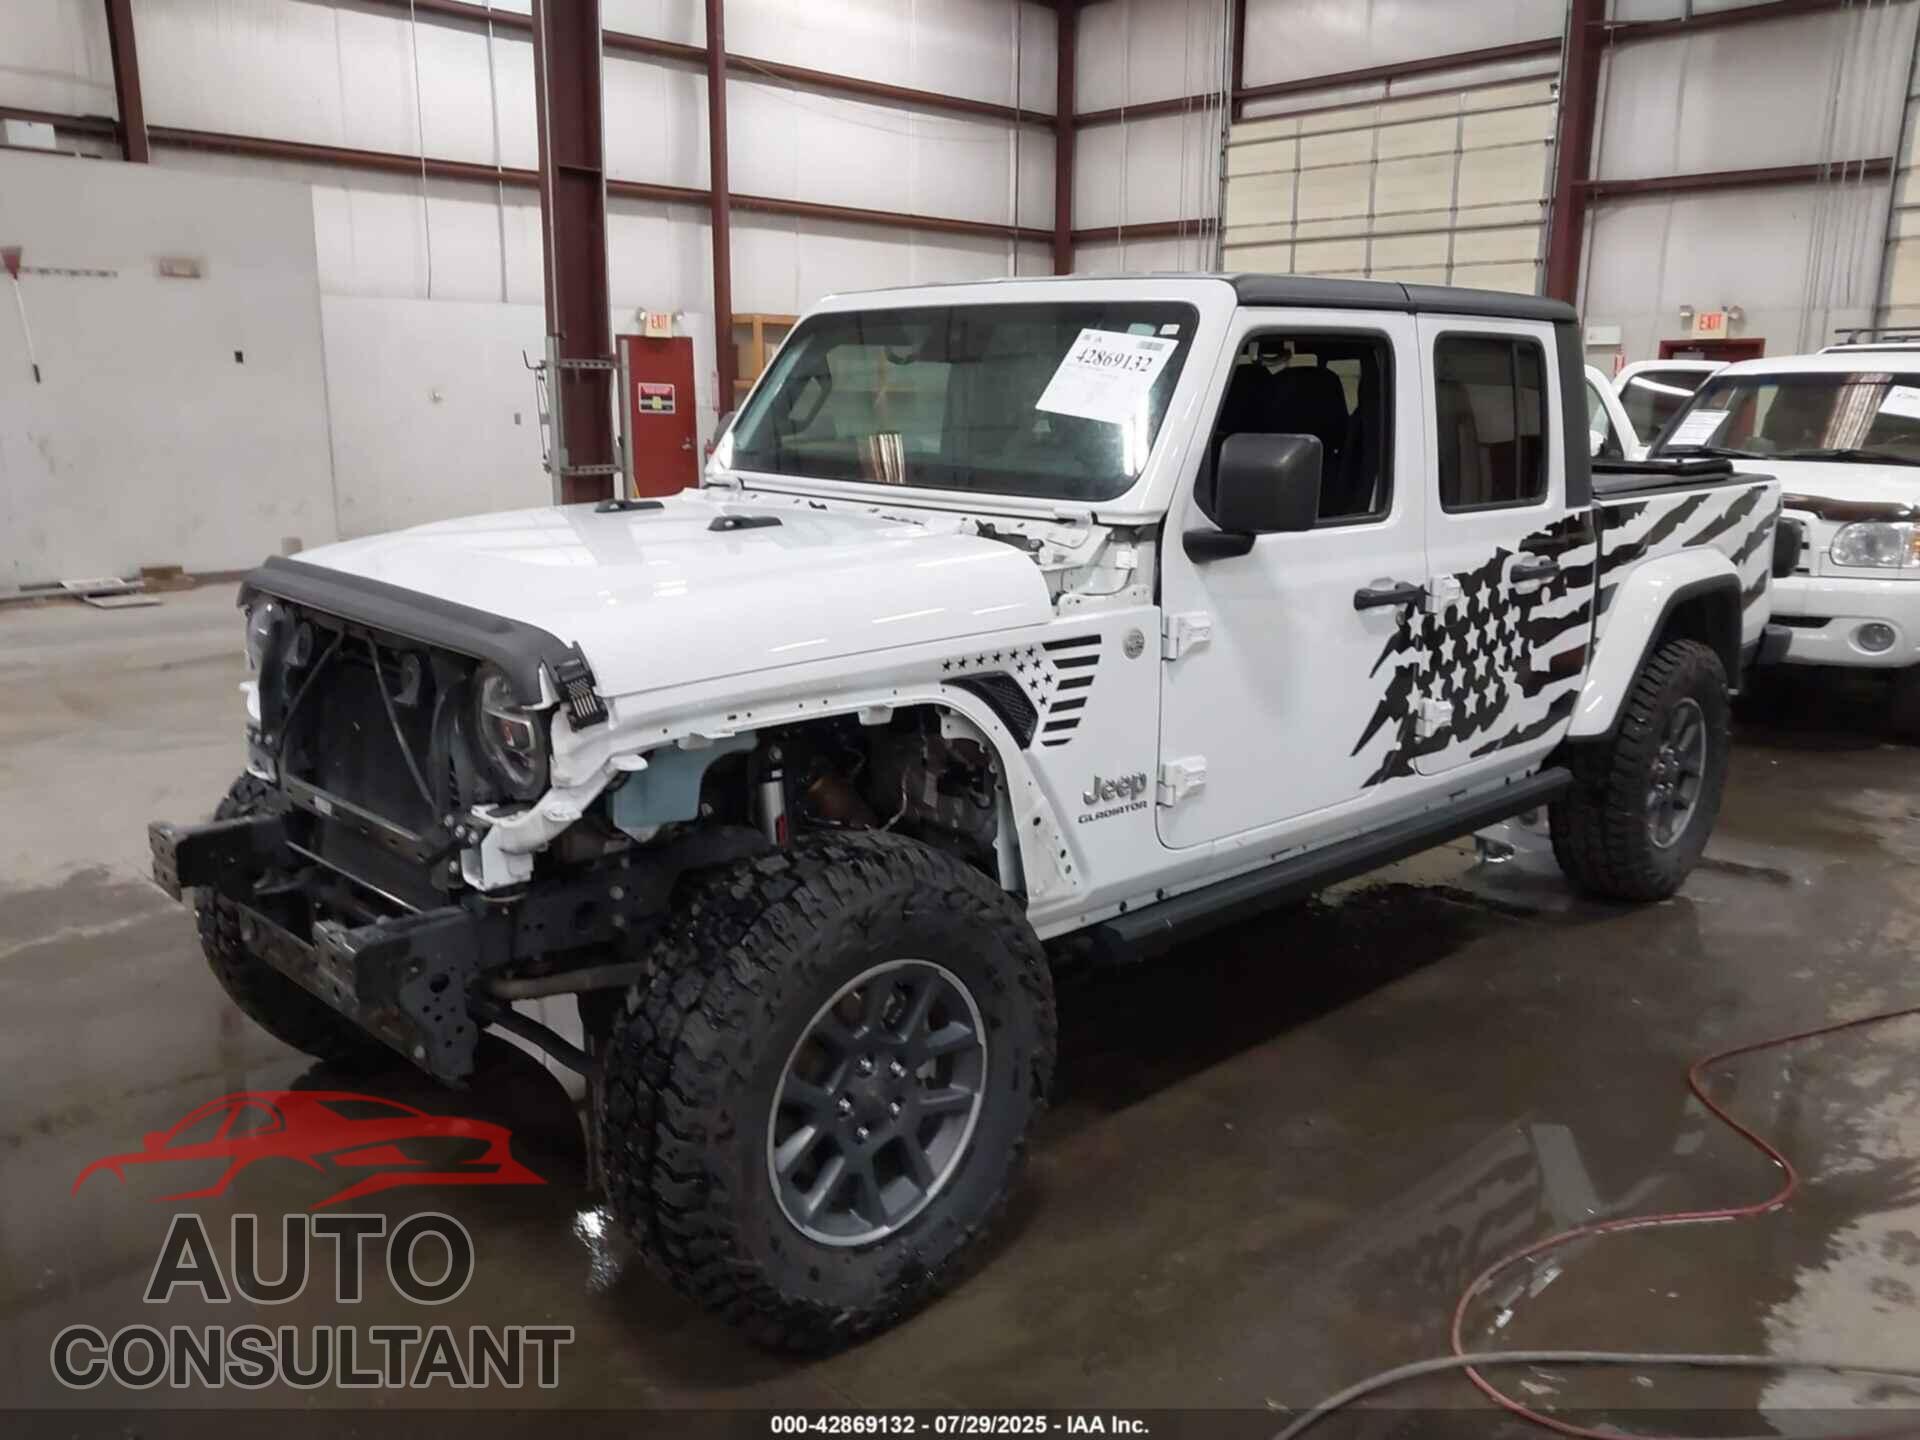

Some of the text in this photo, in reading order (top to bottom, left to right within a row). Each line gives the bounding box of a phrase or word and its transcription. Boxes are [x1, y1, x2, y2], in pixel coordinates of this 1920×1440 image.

[1699, 313, 1723, 331] EXIT
[1076, 347, 1153, 373] 42869132
[1082, 772, 1147, 806] Jeep
[1078, 800, 1148, 824] GLADIATOR
